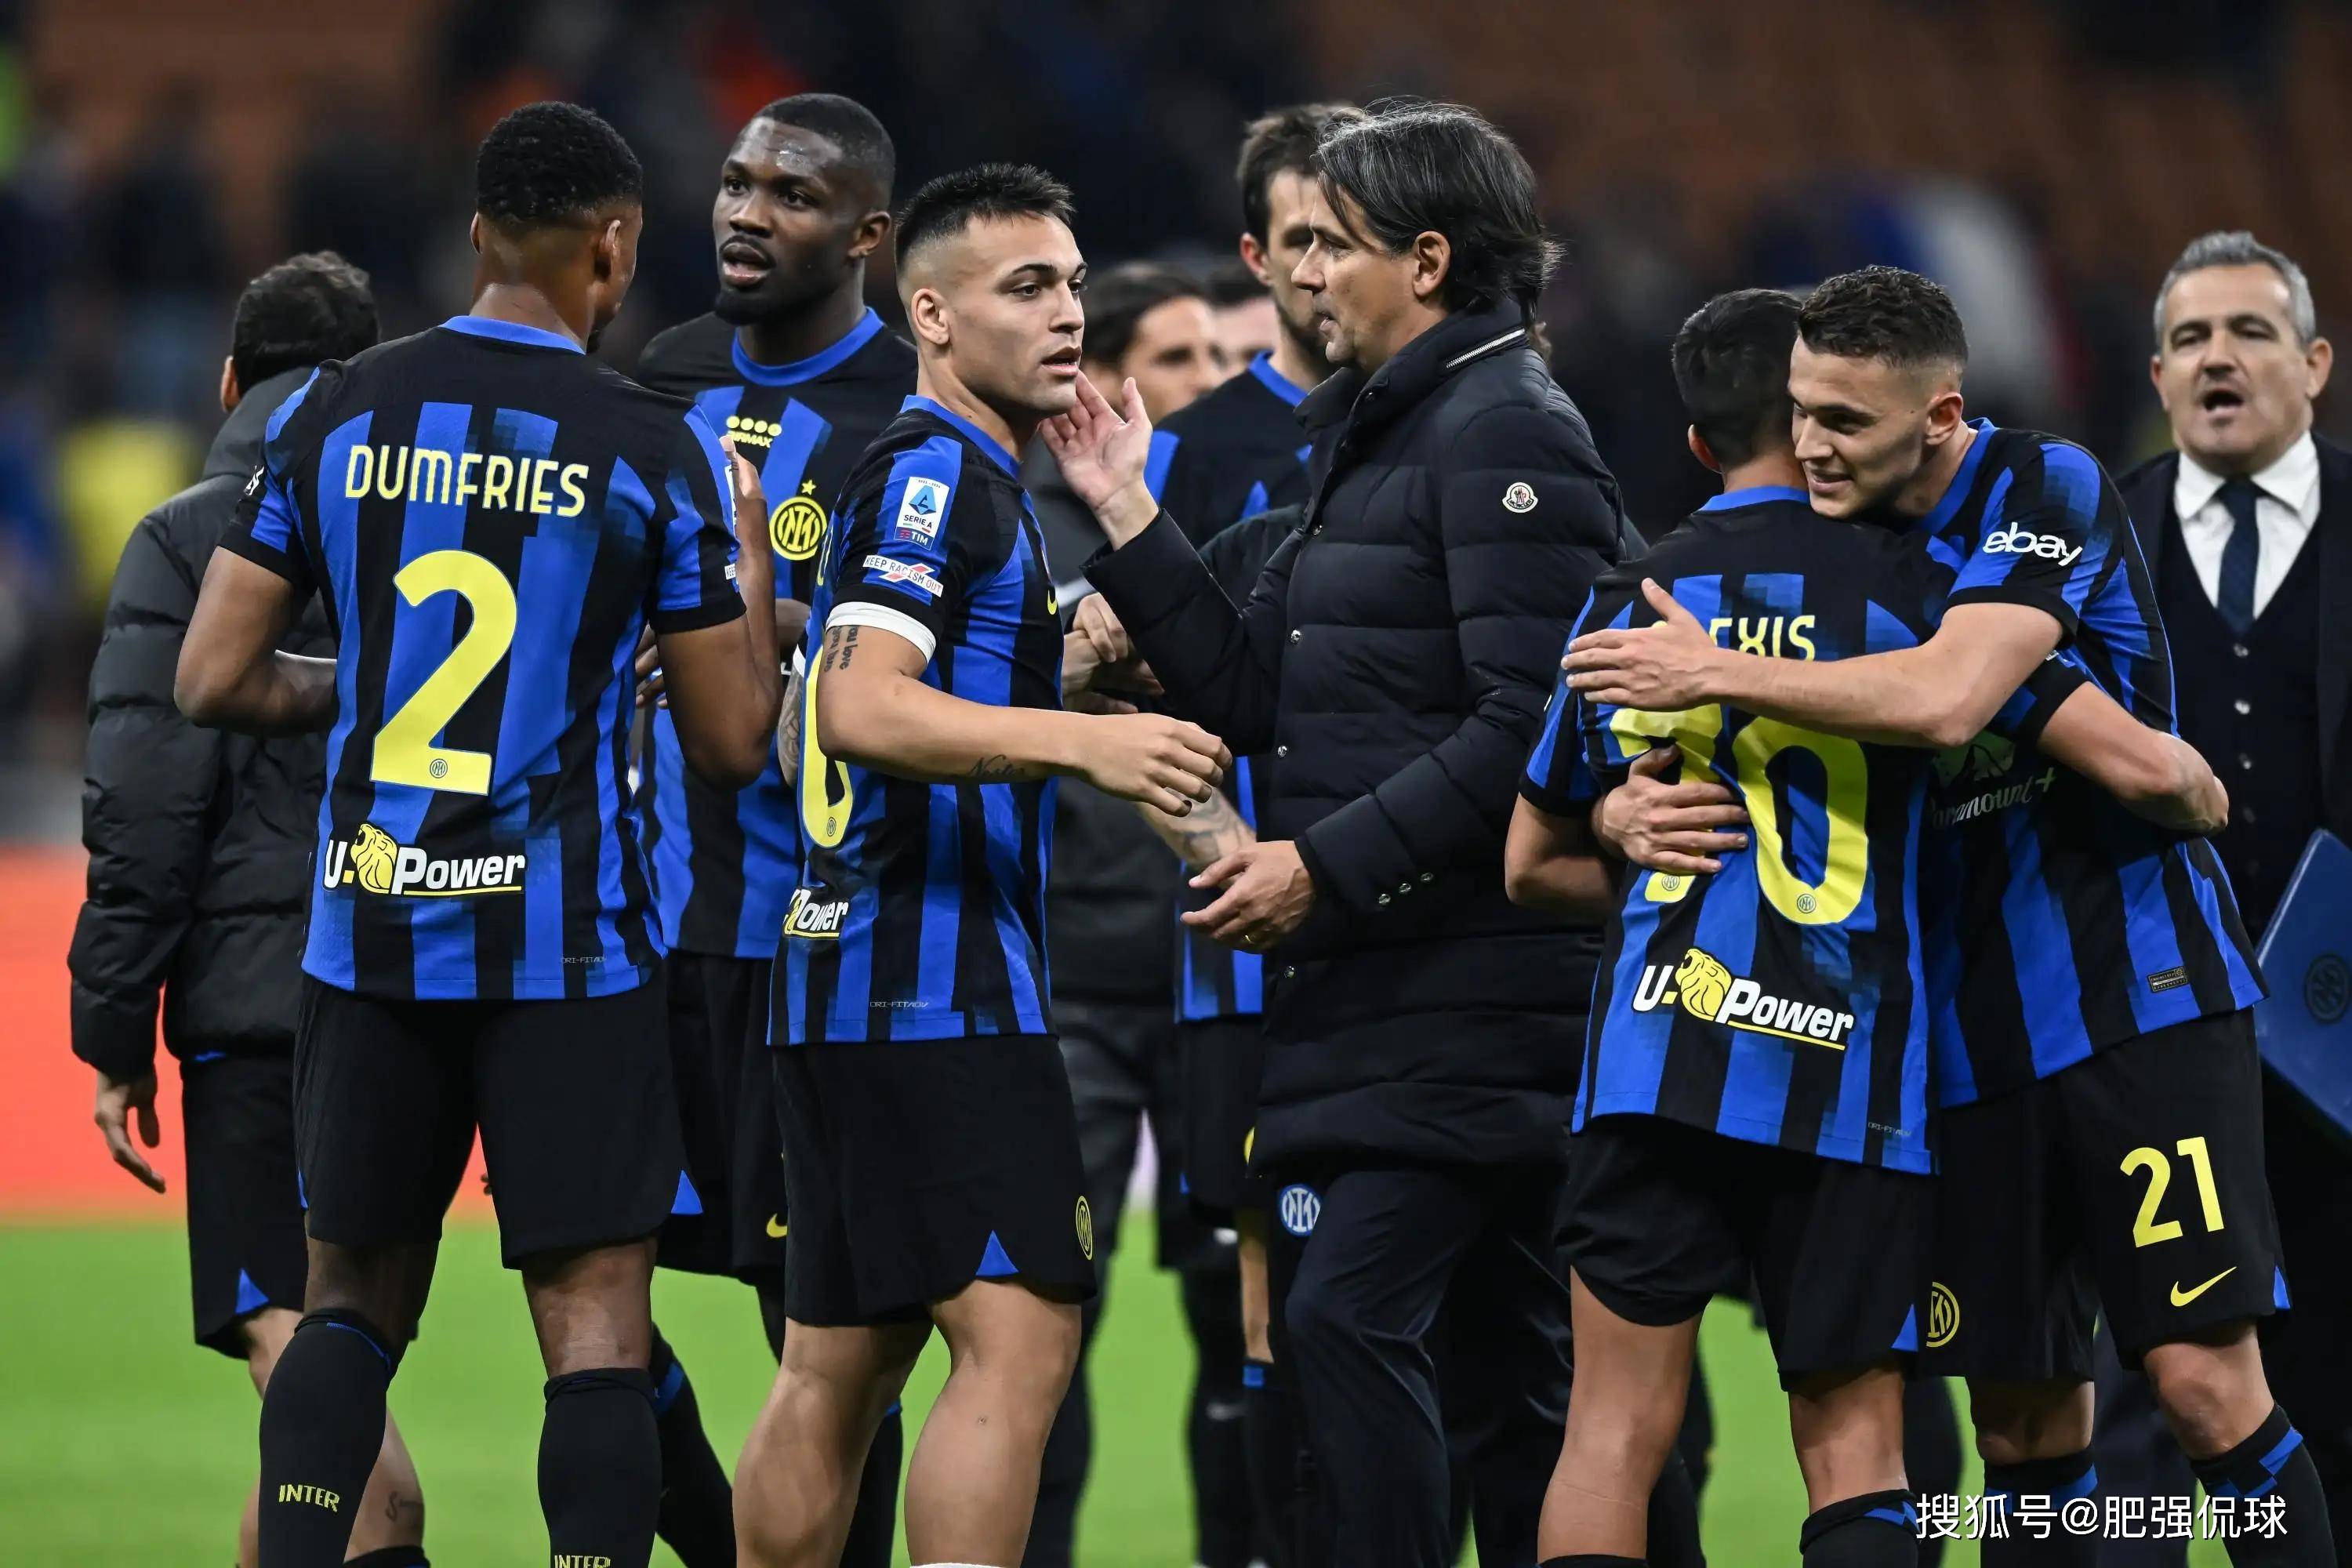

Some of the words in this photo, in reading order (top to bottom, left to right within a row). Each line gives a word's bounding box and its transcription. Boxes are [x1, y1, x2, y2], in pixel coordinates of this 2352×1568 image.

[345, 445, 589, 517] DUMFRIES
[904, 514, 925, 525] SERIE
[926, 521, 933, 529] A
[911, 530, 928, 546] TIM
[1982, 521, 2083, 567] ebay
[865, 556, 887, 568] KEEP
[890, 560, 924, 584] RACISM
[925, 579, 942, 593] OUT
[370, 550, 517, 796] 2
[2119, 1135, 2225, 1248] 21
[278, 1483, 340, 1513] INTER
